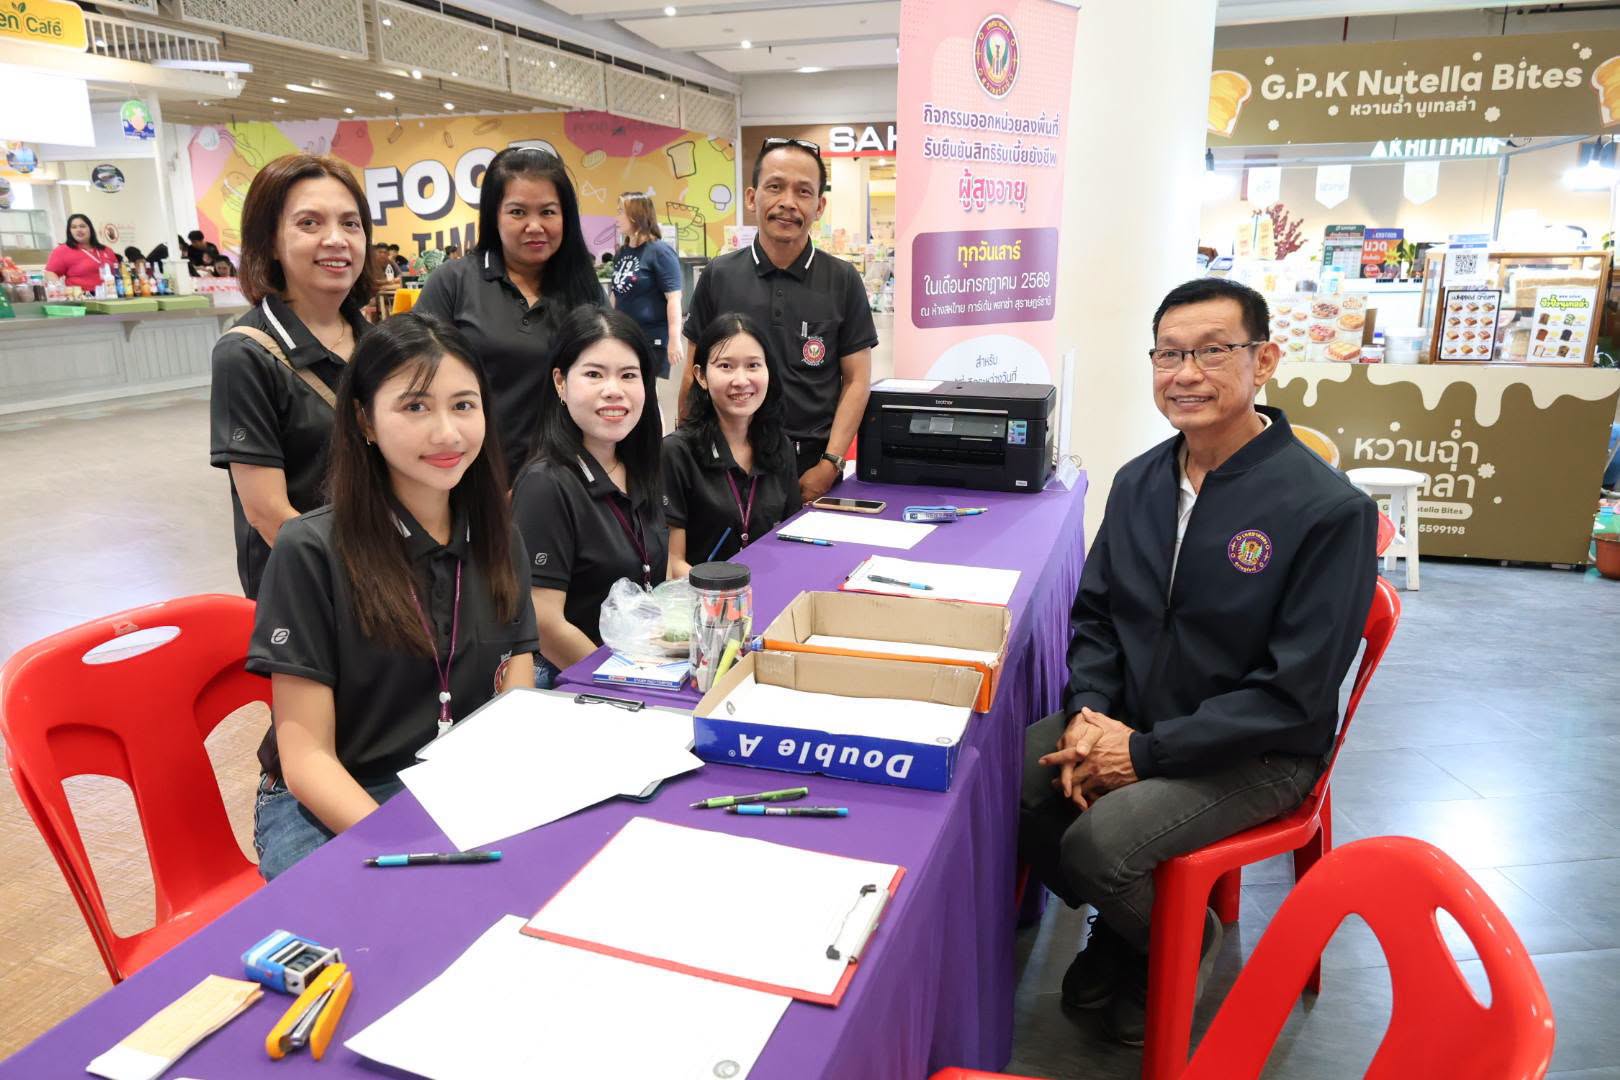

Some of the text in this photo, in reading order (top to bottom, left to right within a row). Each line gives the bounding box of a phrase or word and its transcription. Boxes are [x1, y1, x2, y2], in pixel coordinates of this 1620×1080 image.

[26, 16, 62, 37] Café
[1261, 60, 1583, 100] G.P.K Nutella Bites
[923, 104, 1060, 136] กิจกรรมออกหน่วยลงพื้นที่
[1350, 94, 1477, 118] หวานฉ่ำ นูเทลล่า
[364, 139, 559, 226] FOO
[958, 168, 1026, 209] ผู้สูงอายุ
[412, 222, 477, 257] TIM
[957, 239, 1022, 268] ทุกวันเสาร์
[924, 271, 1051, 296] ในเดือนกรกฎาคม 2569
[975, 353, 998, 368] สำหรับ
[1354, 418, 1479, 465] หวานฉ่ำ
[738, 734, 914, 779] Double A
